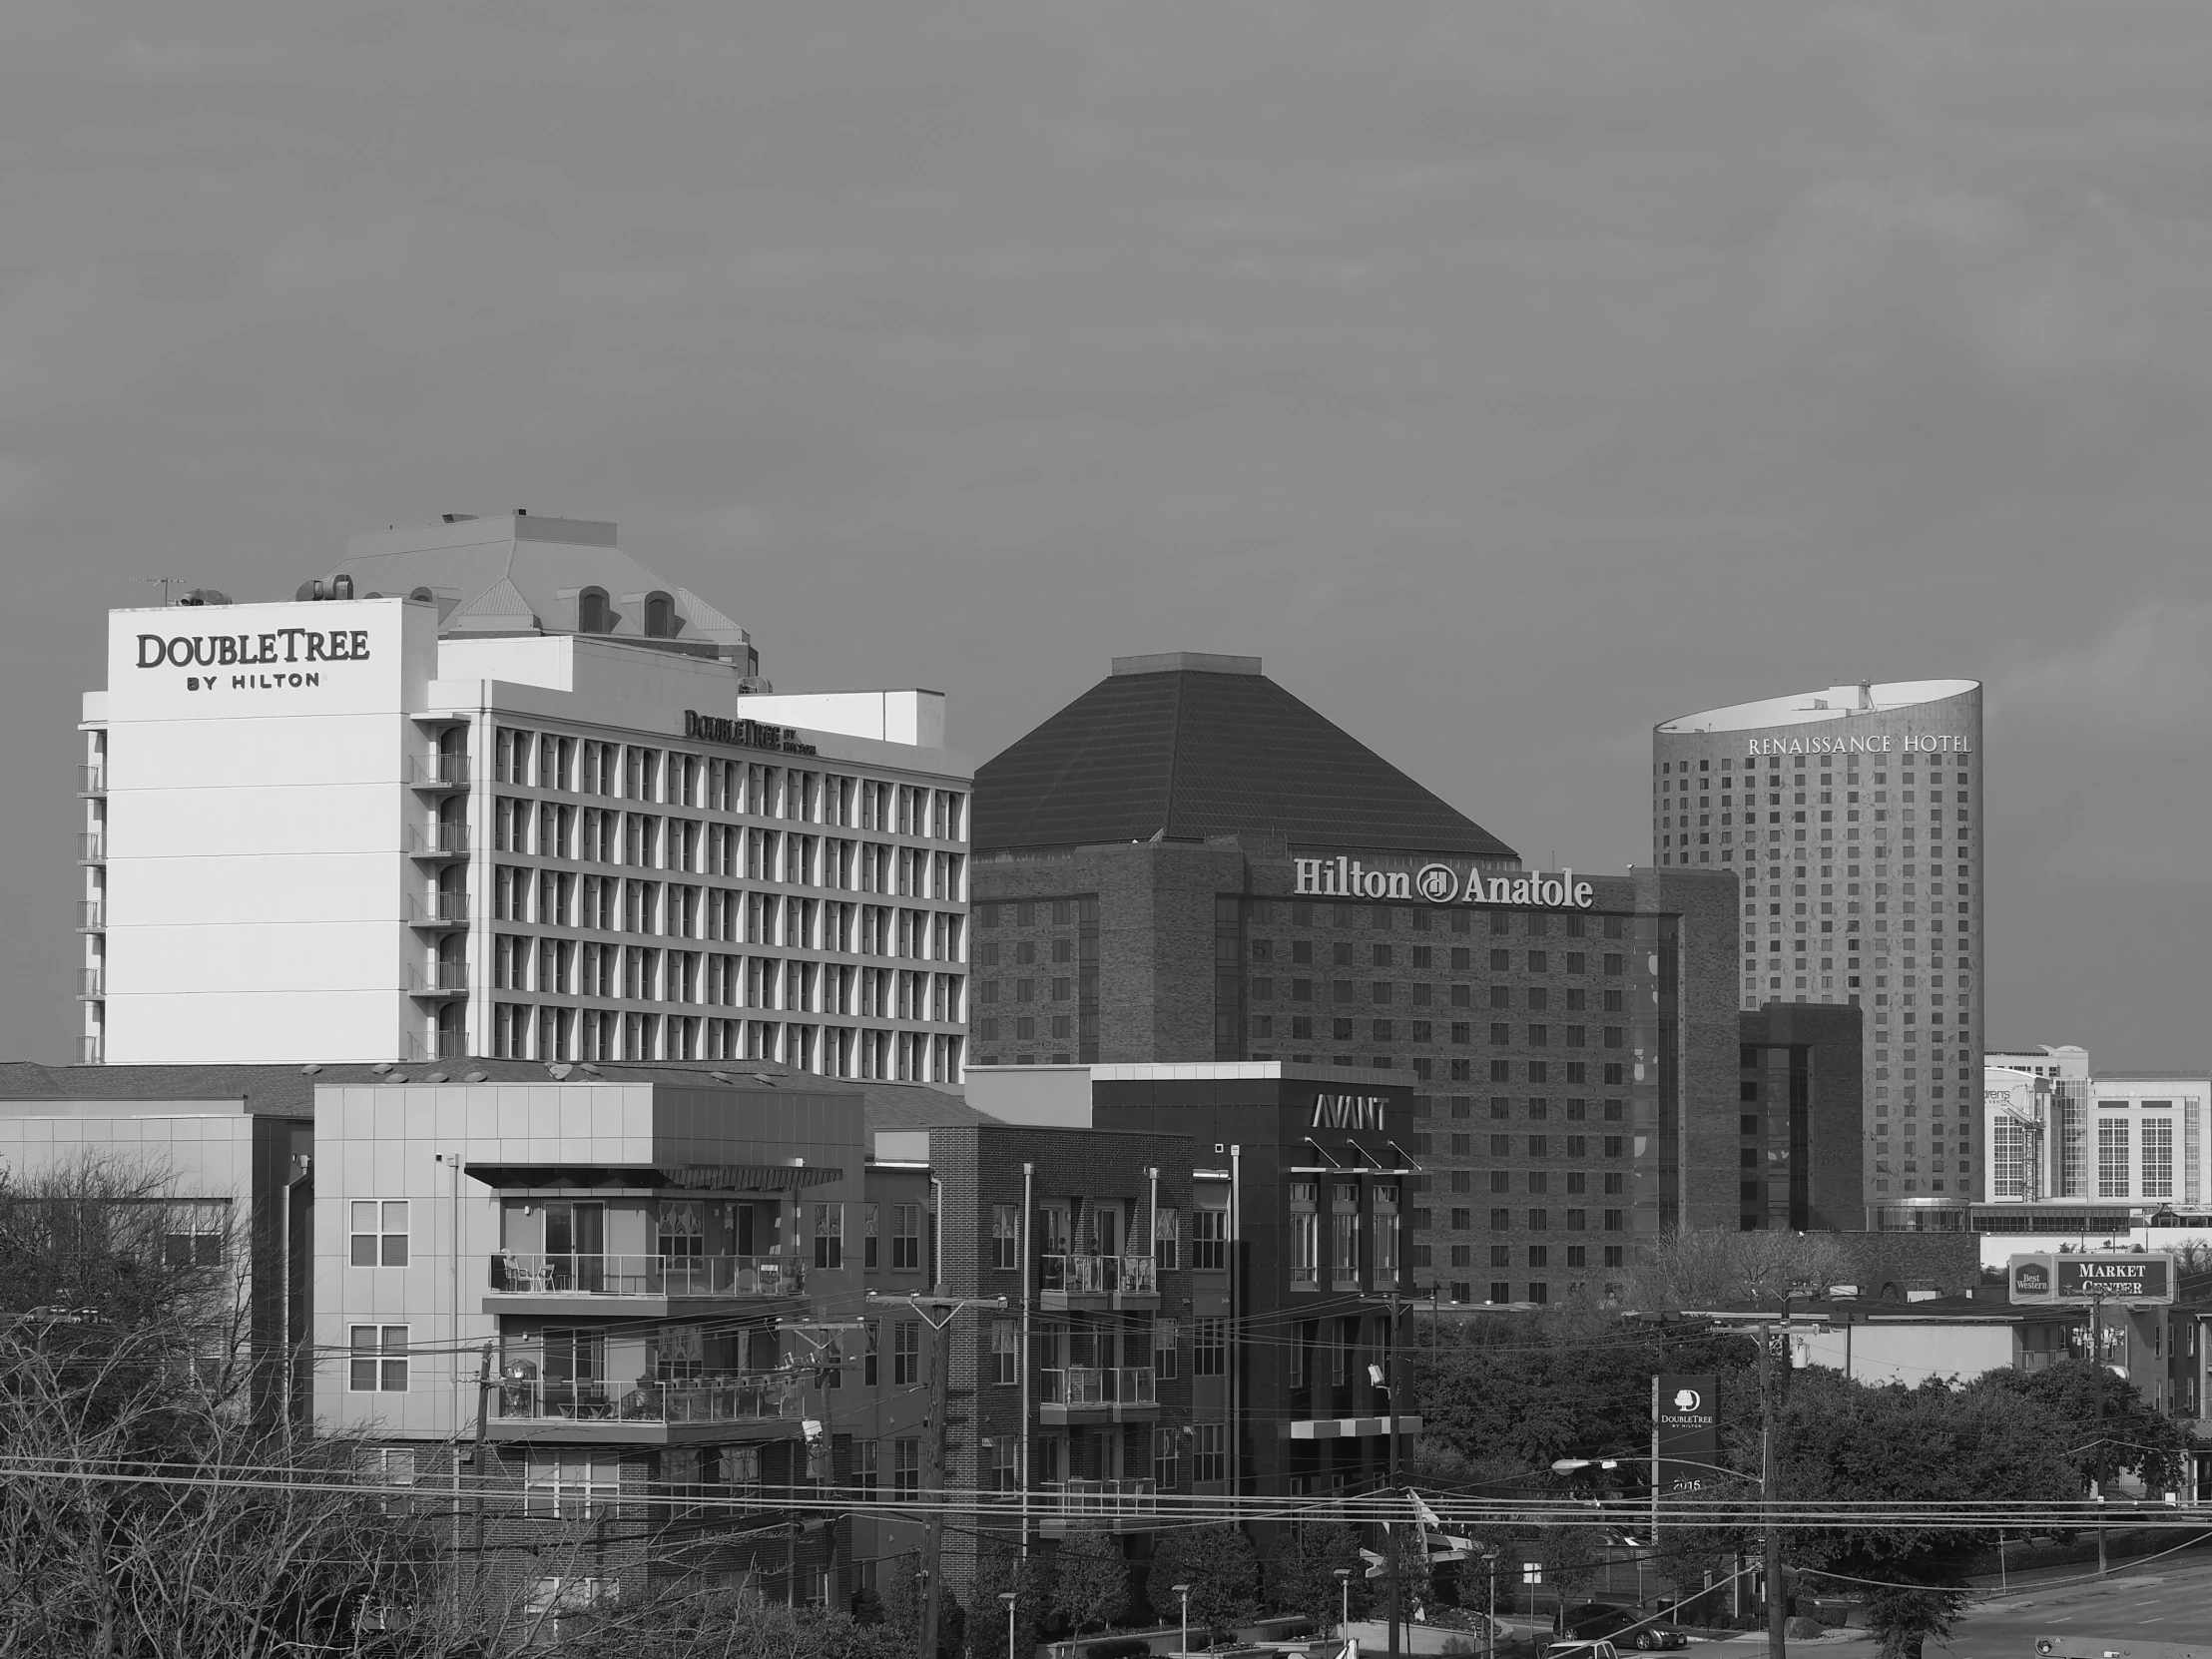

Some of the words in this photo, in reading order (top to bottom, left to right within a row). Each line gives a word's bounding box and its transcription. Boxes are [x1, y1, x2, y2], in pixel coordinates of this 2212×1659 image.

[136, 628, 370, 669] DOUBLETREE
[187, 675, 218, 691] BY
[232, 672, 319, 690] HILTON
[684, 709, 782, 750] DOUBLETREE
[783, 728, 797, 740] BY
[783, 742, 817, 756] HILTON
[1749, 735, 1892, 756] RENAISSANCE
[1904, 735, 1972, 753] HOTEL
[1294, 855, 1412, 899] Hilton
[1461, 866, 1593, 908] Anatole
[1311, 1093, 1390, 1131] AVANT
[2023, 1273, 2041, 1283] Best
[2078, 1263, 2146, 1278] MARKET
[2016, 1280, 2047, 1291] Western
[1661, 1414, 1713, 1423] DOUBLETREE
[1673, 1479, 1701, 1490] 2015
